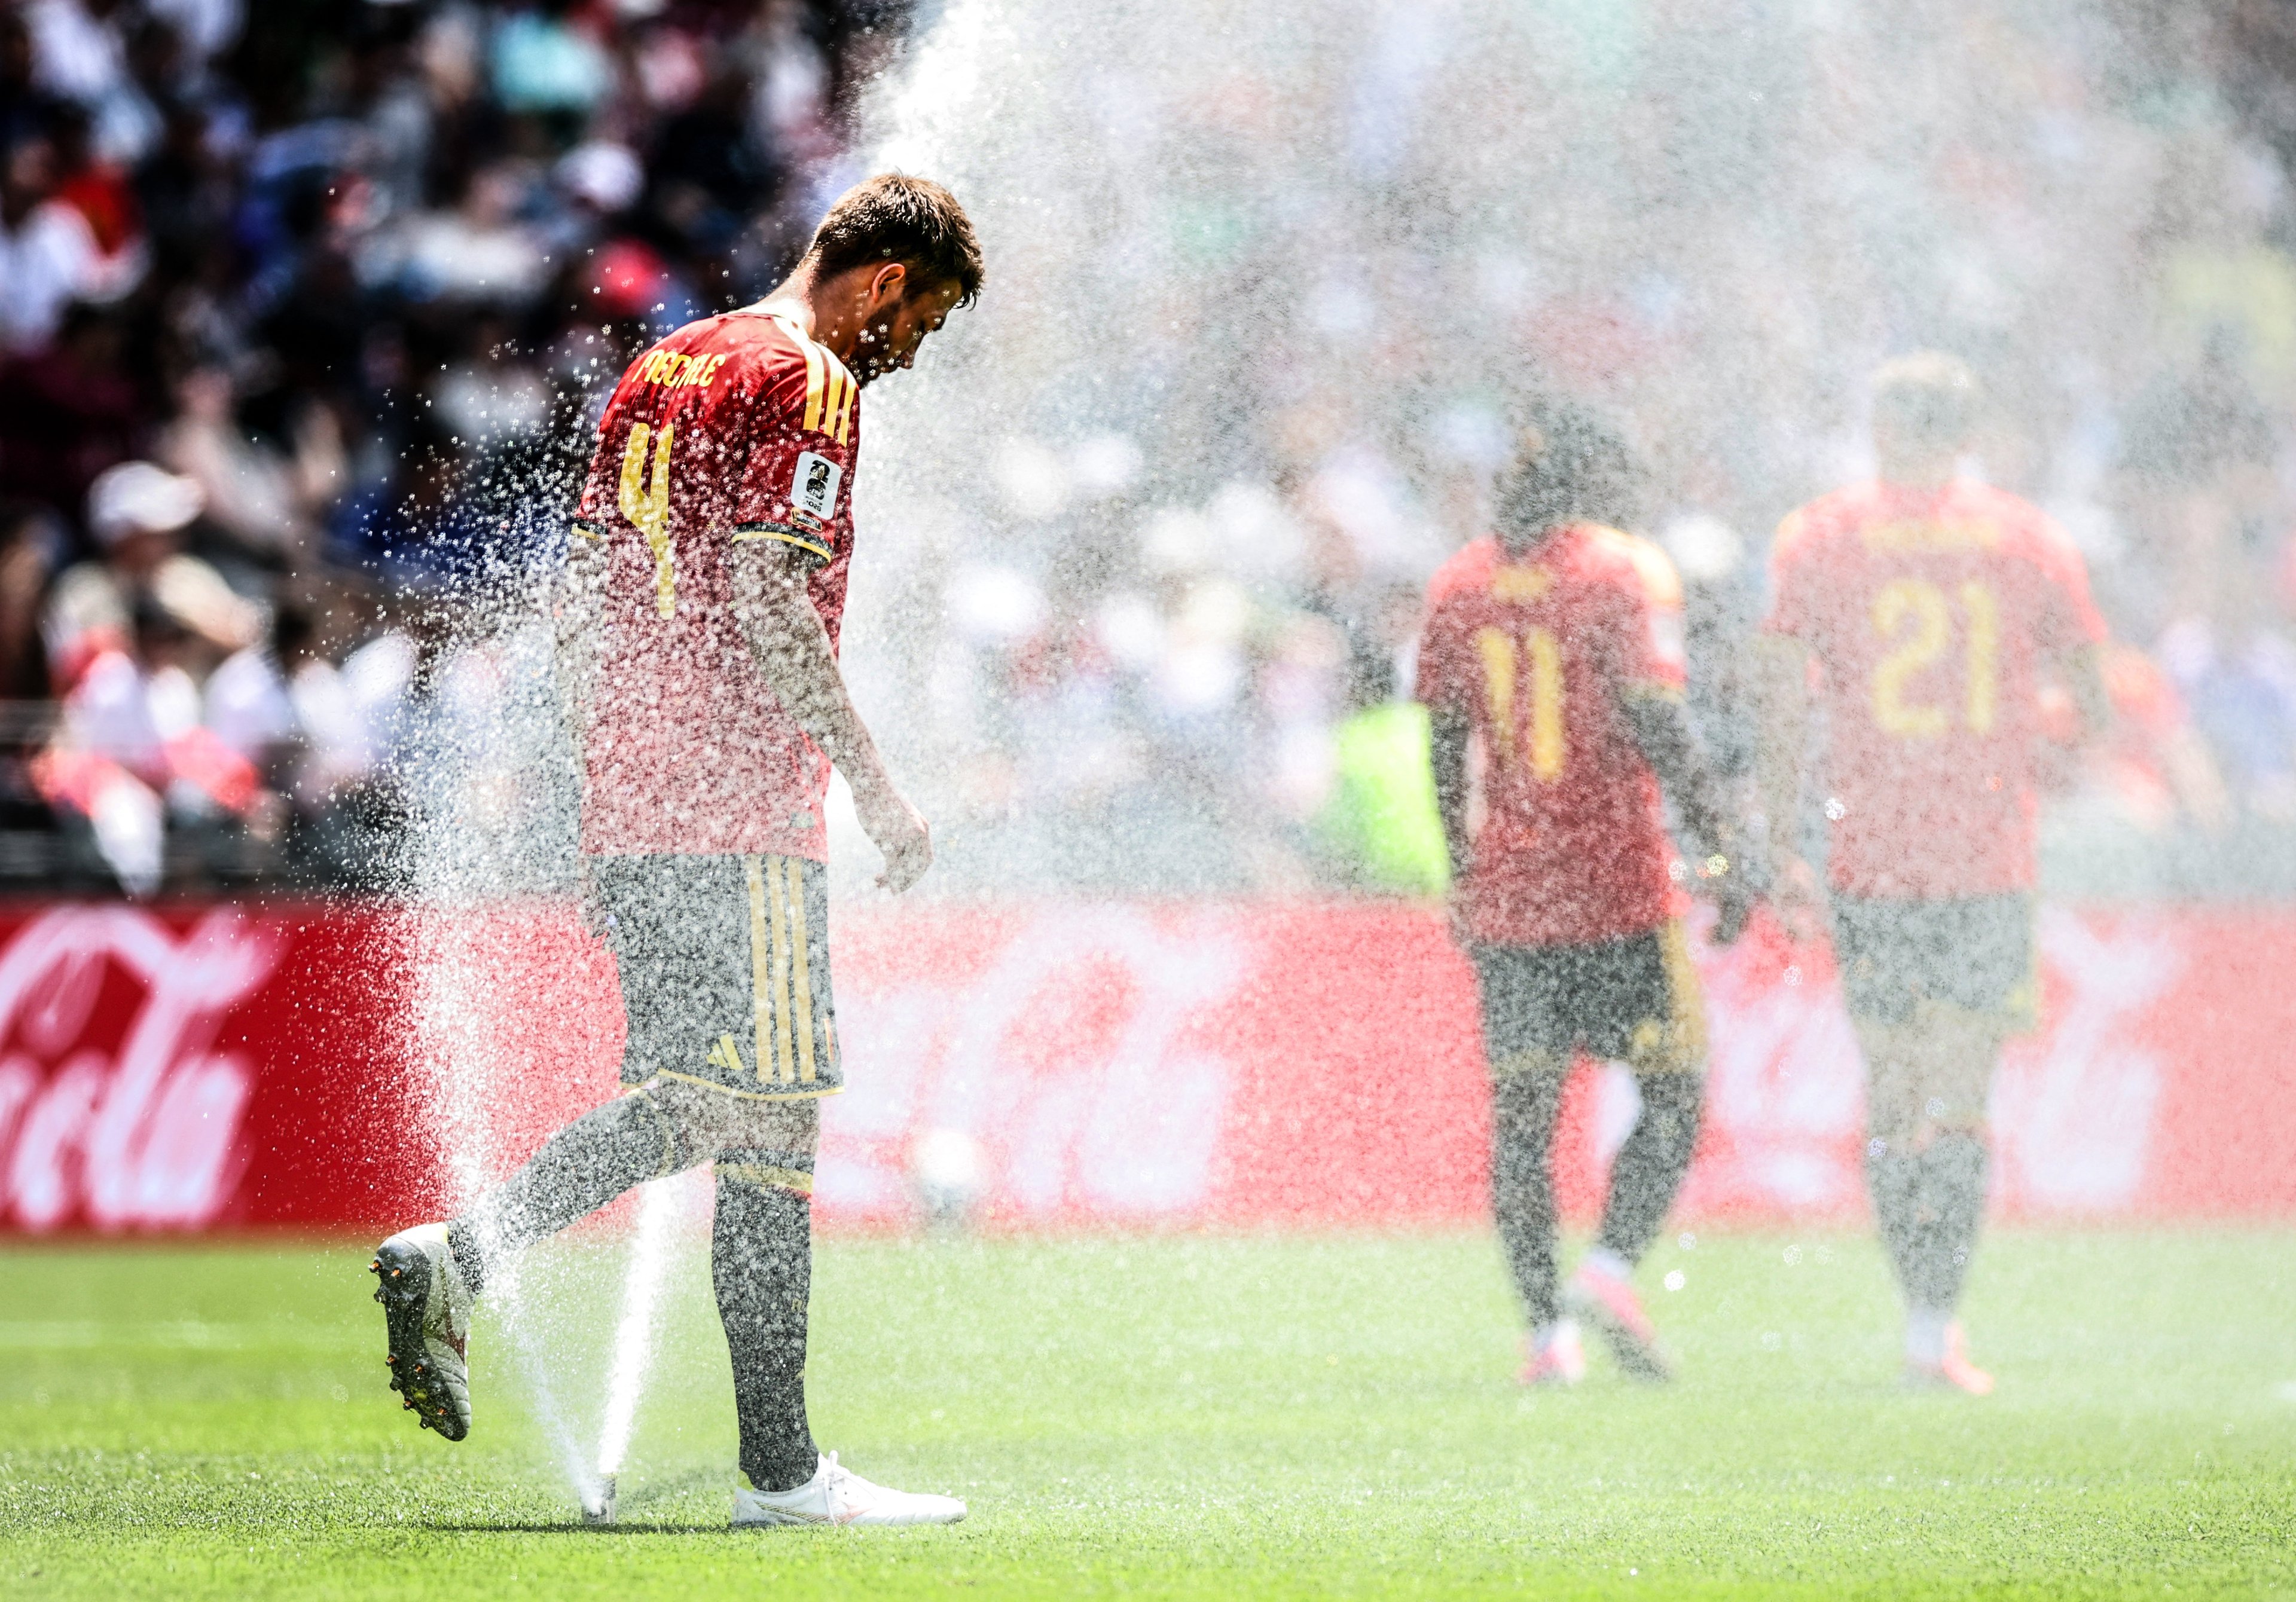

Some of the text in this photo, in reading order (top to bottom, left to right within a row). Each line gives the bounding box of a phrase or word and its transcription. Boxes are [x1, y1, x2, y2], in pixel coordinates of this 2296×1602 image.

[618, 423, 675, 620] 4
[1477, 625, 1563, 781] 11
[1870, 577, 1997, 735] 21
